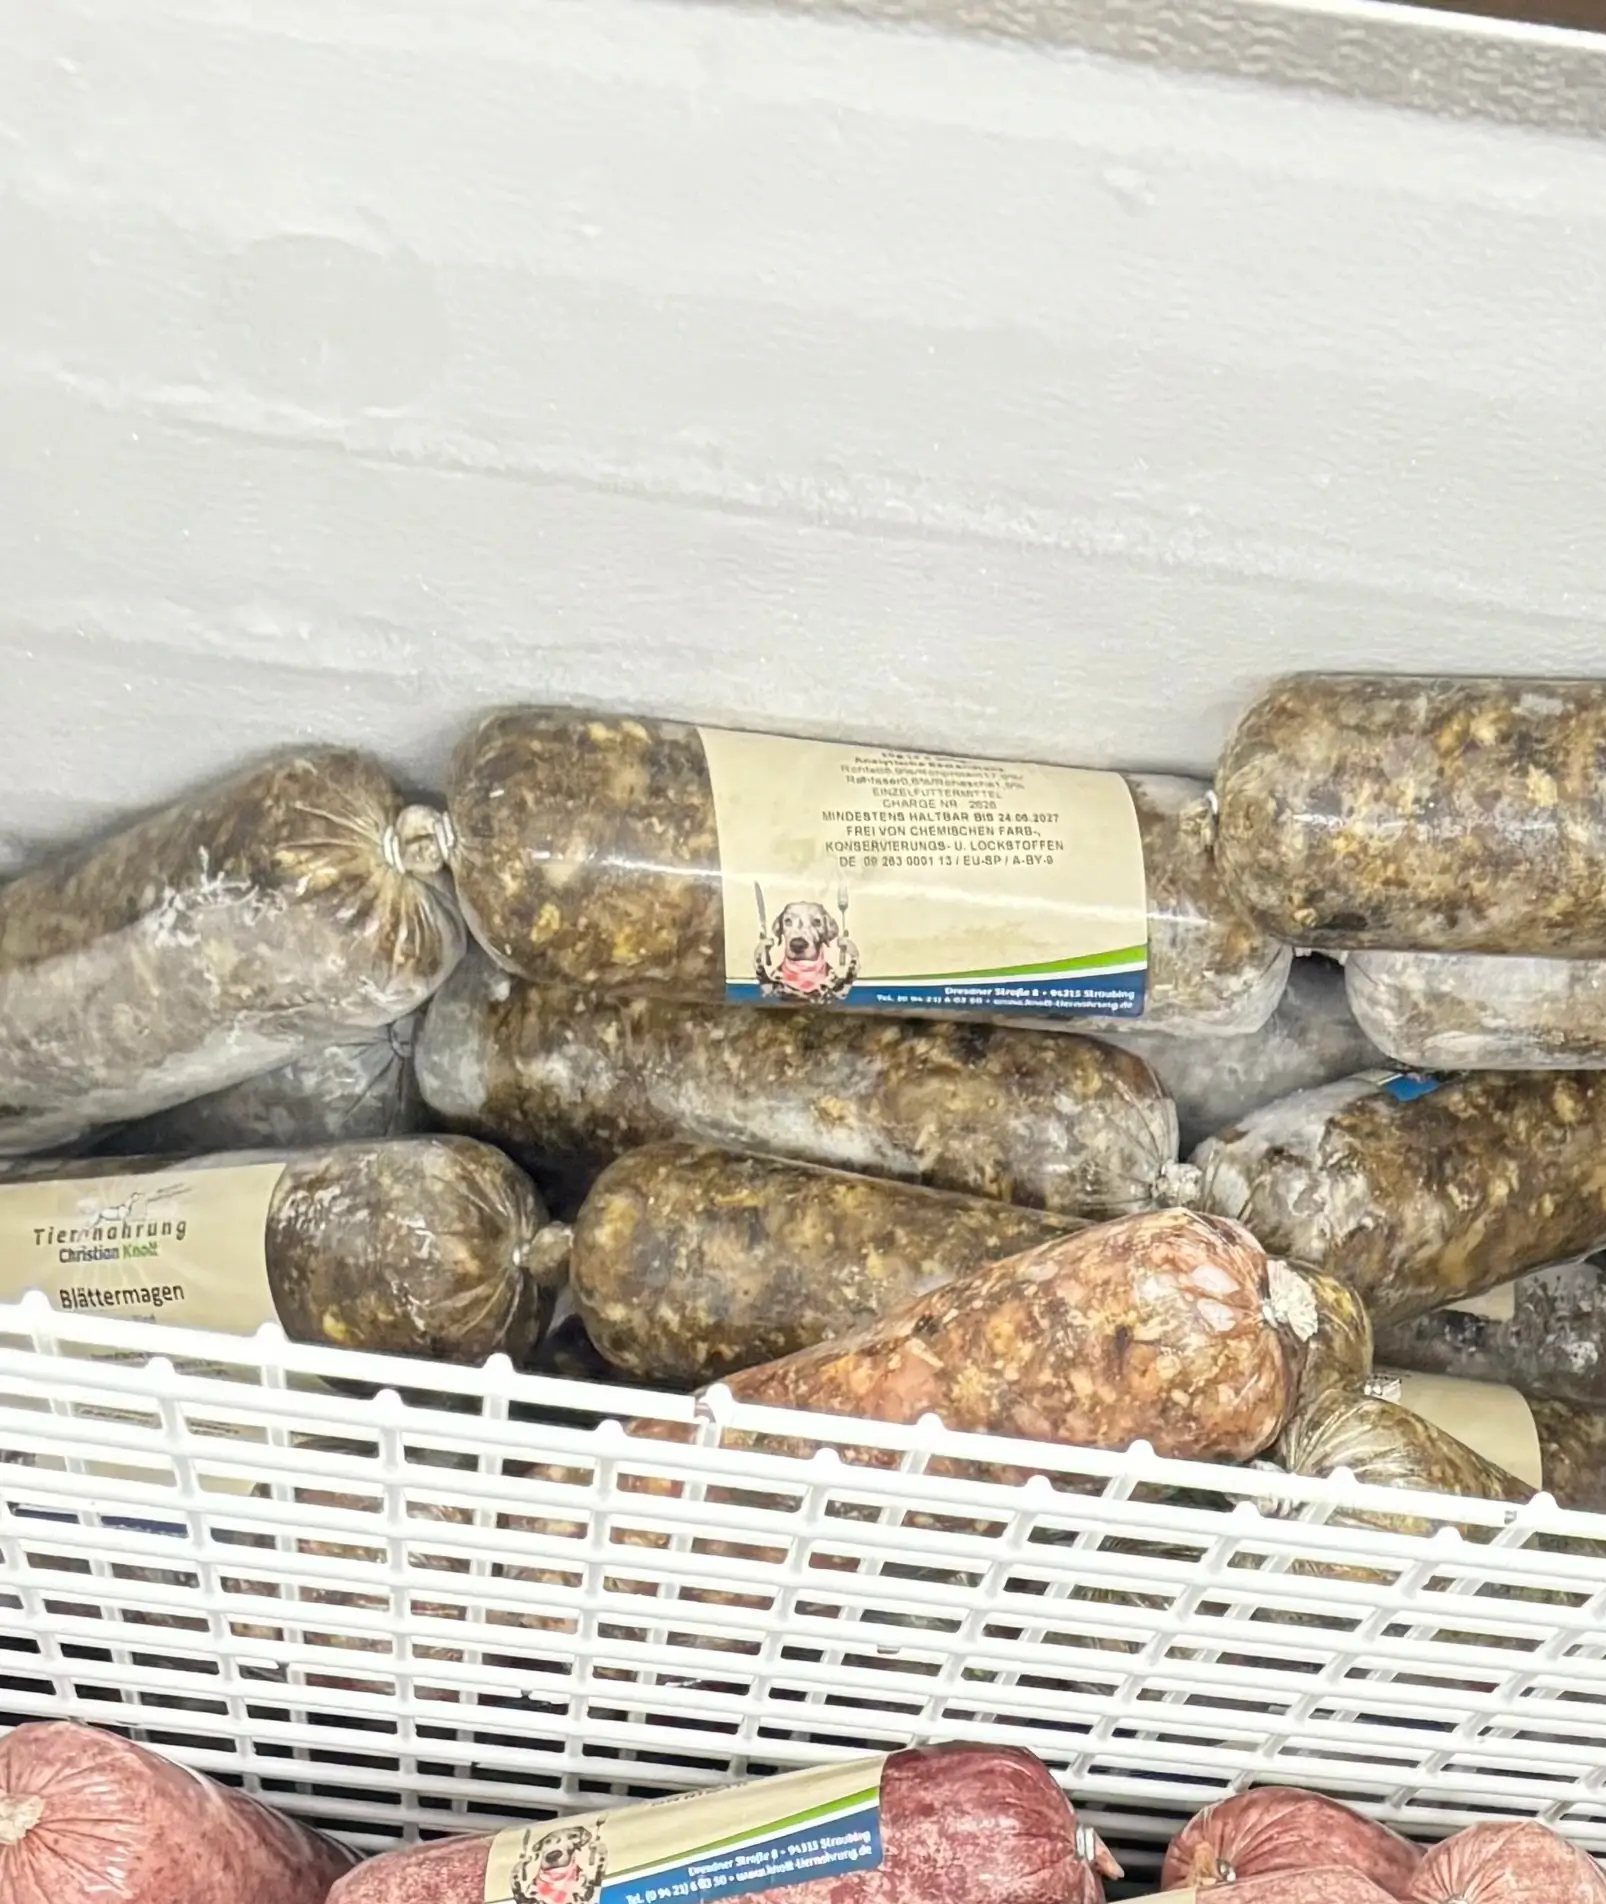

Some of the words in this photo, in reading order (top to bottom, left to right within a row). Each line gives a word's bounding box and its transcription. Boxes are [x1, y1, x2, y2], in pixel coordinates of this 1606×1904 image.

[910, 812, 968, 821] HALTBAR
[847, 826, 875, 836] FREI
[879, 826, 905, 836] VON
[910, 826, 994, 836] CHEMISCHEN
[970, 840, 1063, 851] LOCKSTOFFEN
[840, 856, 855, 867] DE
[59, 1245, 119, 1263] Christian
[123, 1242, 158, 1259] Knott
[60, 1286, 184, 1309] Blättermagen
